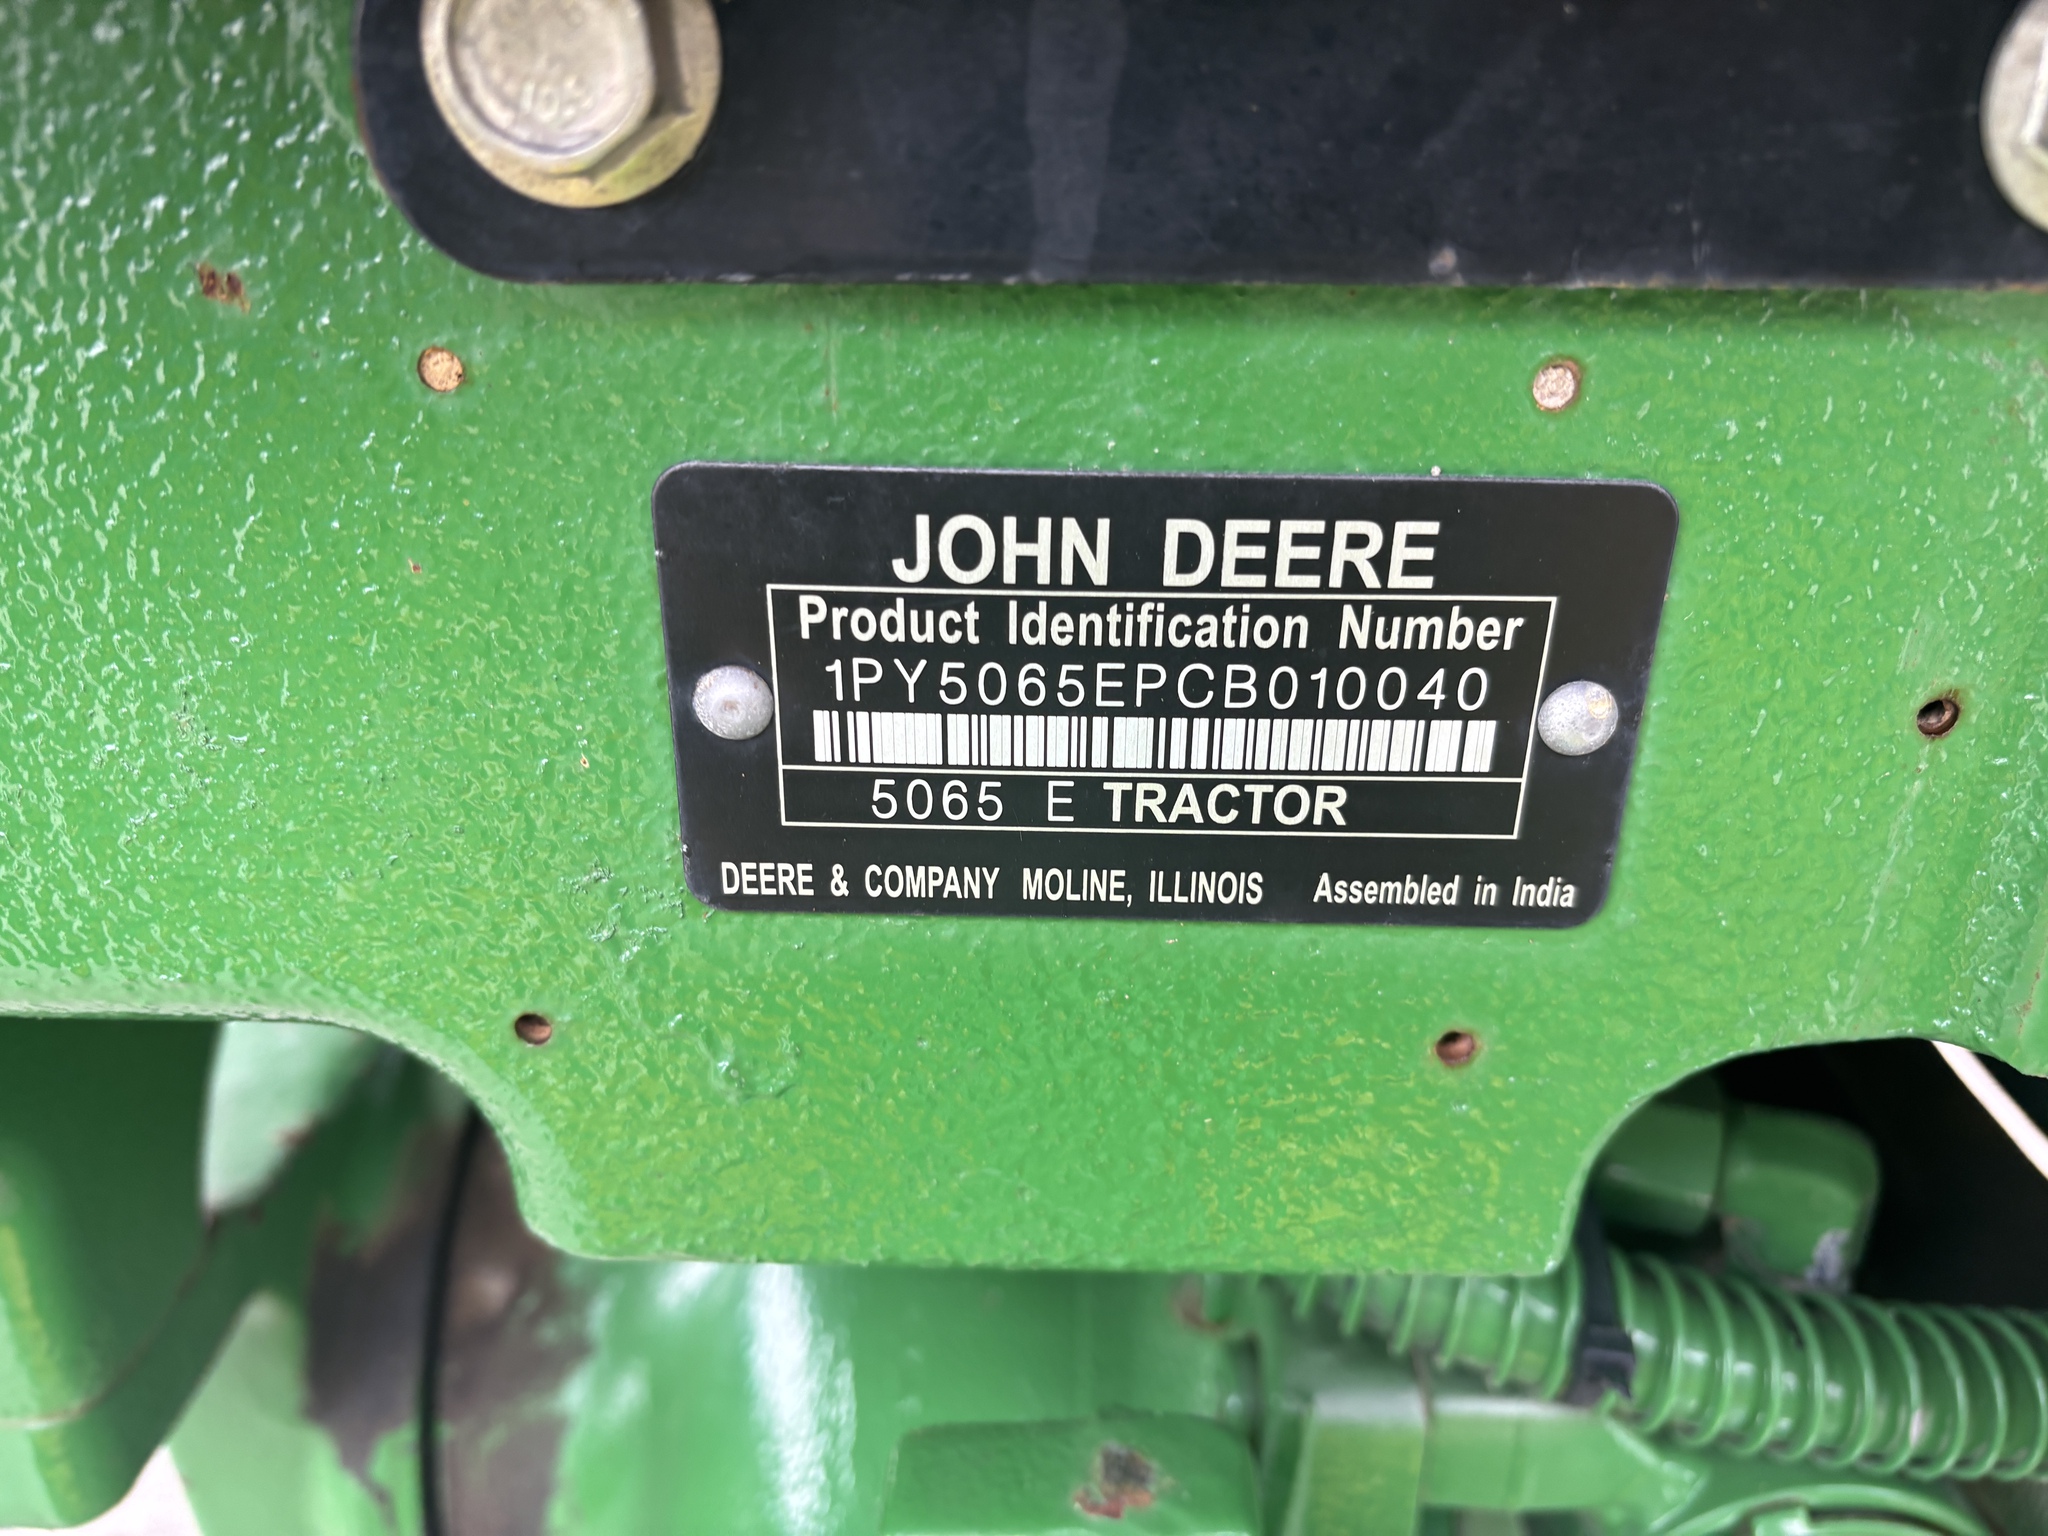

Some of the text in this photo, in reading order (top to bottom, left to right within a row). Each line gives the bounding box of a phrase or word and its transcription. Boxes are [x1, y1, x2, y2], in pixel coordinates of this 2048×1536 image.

[892, 514, 1440, 589] JOHN DEERE
[799, 594, 1524, 650] Product Identification Number
[824, 657, 1488, 711] 1PY5065EPCB010040
[871, 779, 1347, 826] 5065 E TRACTOR
[721, 862, 1263, 907] DEERE & COMPANY MOLINE, ILLINOIS
[1313, 873, 1577, 907] Assembled in India
